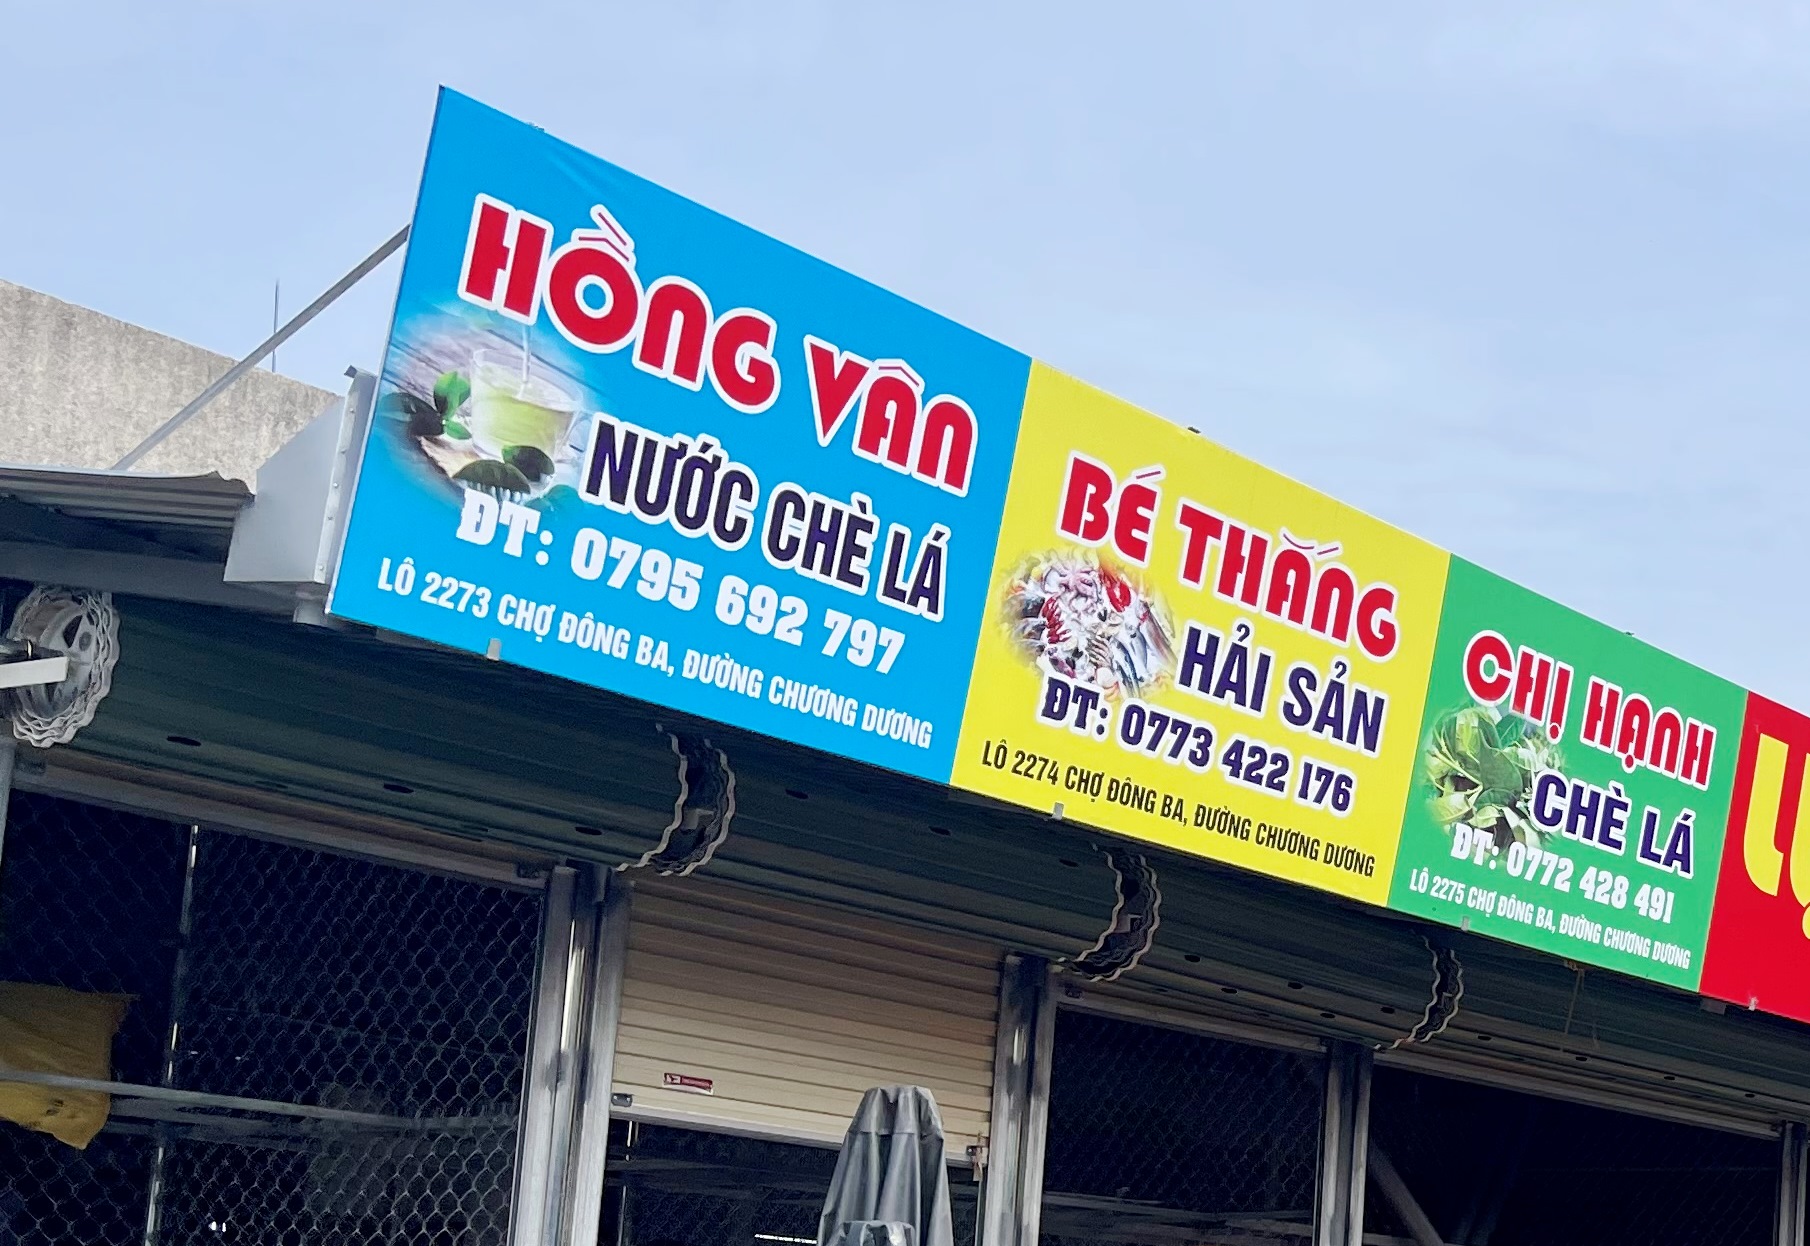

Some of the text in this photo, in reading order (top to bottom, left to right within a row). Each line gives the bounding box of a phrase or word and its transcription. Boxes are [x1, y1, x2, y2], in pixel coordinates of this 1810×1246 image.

[461, 200, 976, 494] HỒNG VÂN
[456, 489, 905, 675] ĐT: 0795 692 797
[586, 420, 949, 618] NƯỚC CHÈ LÁ
[1060, 456, 1398, 659] BÉ THẮNG
[378, 558, 932, 749] LÔ 2273 CHỢ ĐÔNG BA, ĐƯỜNG CHƯƠNG DƯƠNG
[1178, 622, 1386, 755] HẢI SẢN
[1465, 633, 1716, 787] CHỊ HẠNH
[982, 738, 1375, 877] LÔ 2274 CHỢ ĐÔNG BA, ĐƯỜNG CHƯƠNG DƯƠNG
[1041, 677, 1354, 813] ĐT: 0773 422 176
[1450, 822, 1675, 923] ĐT: 0772 428 491
[1533, 771, 1695, 877] CHÈ LÁ
[1409, 867, 1691, 970] LÔ 2275 CHỢ ĐÔNG BA, ĐƯỜNG CHƯƠNG DƯƠNG
